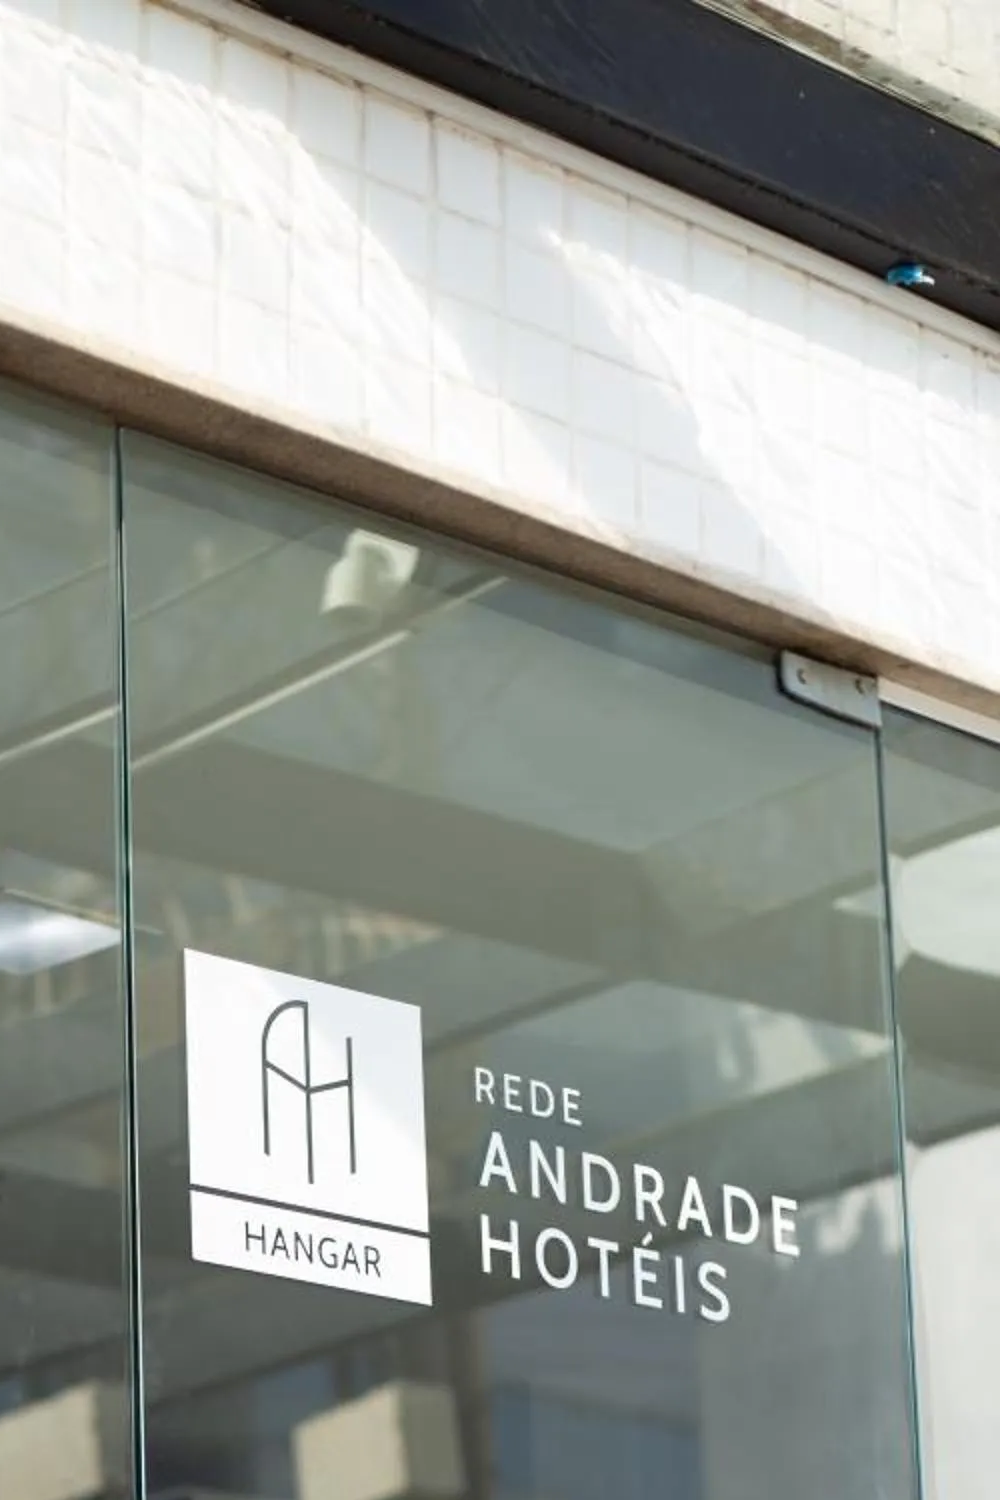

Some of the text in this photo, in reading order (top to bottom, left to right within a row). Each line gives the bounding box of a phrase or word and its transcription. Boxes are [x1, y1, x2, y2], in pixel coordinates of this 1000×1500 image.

[475, 1067, 583, 1126] REDE
[480, 1132, 799, 1257] ANDRADE
[244, 1222, 382, 1278] HANGAR
[480, 1214, 731, 1322] HOTÉIS
